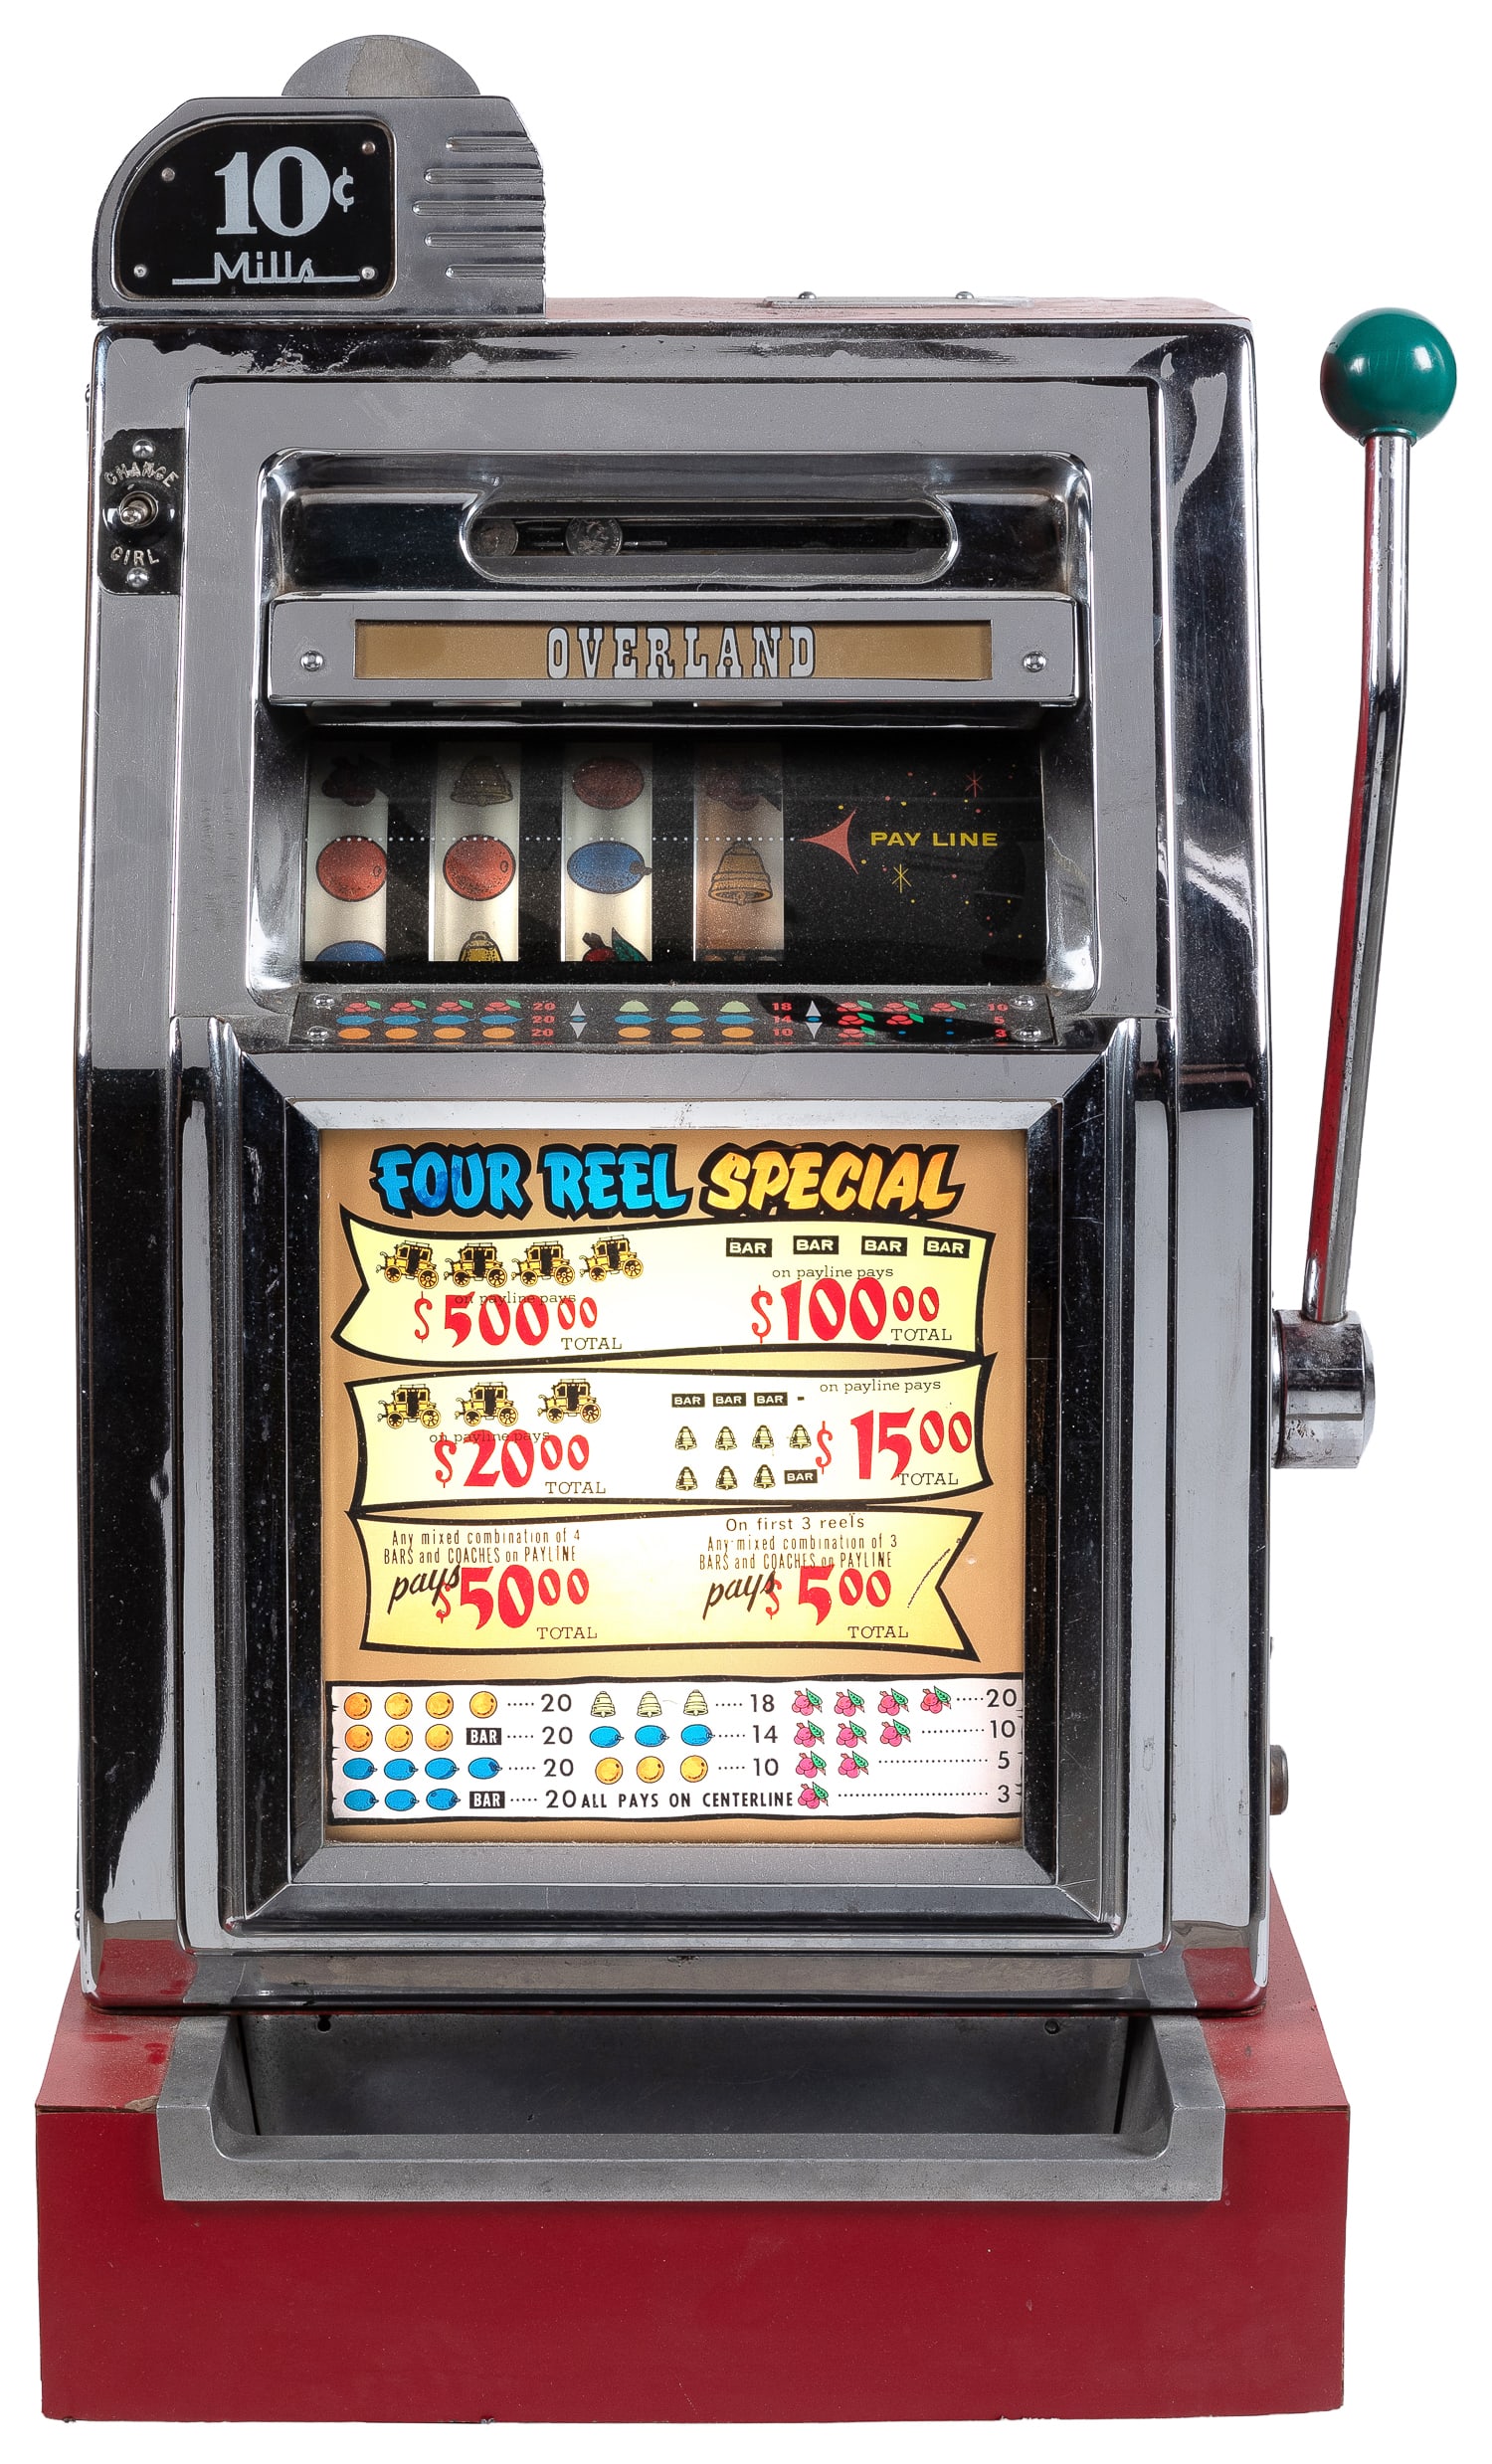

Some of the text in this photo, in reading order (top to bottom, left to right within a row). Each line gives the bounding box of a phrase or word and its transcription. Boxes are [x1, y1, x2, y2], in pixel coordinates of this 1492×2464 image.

[214, 146, 354, 237] 10¢
[213, 251, 315, 284] Mills
[103, 461, 180, 487] CHANGE
[110, 546, 160, 566] GIRL
[547, 625, 816, 679] OVERLAND
[870, 832, 998, 847] PAY LINE
[533, 1002, 556, 1012] 20
[772, 1002, 793, 1012] 18
[532, 1015, 555, 1025] 20
[772, 1015, 792, 1025] 14
[995, 1016, 1005, 1026] 5
[531, 1028, 554, 1038] 20
[995, 1029, 1008, 1039] 3
[374, 1144, 963, 1218] FOUR REEL SPECIAL
[729, 1238, 965, 1255] BAR BAR BAR BAR
[772, 1265, 893, 1280] on payline pays
[455, 1292, 576, 1308] on payline pays
[891, 1328, 952, 1341] TOTAL
[562, 1337, 623, 1350] TOTAL
[820, 1380, 942, 1395] on payline pays
[673, 1394, 785, 1407] BAR BAR BAR
[429, 1432, 448, 1443] on
[513, 1431, 550, 1443] pays
[787, 1471, 814, 1482] BAR
[897, 1472, 959, 1486] TOTAL
[545, 1481, 606, 1494] TOTAL
[726, 1518, 748, 1532] On
[757, 1517, 793, 1531] first
[802, 1517, 812, 1529] 3
[392, 1527, 580, 1550] Any mixed combination of 4
[708, 1534, 897, 1553] Any mixed combination of 3
[384, 1545, 576, 1565] BARS and COACHES on PAYLINE
[699, 1551, 892, 1571] BARS and COACHES on PAYLINE
[387, 1564, 462, 1615] pays
[702, 1568, 776, 1620] pays
[536, 1626, 598, 1640] TOTAL
[847, 1625, 909, 1639] TOTAL
[540, 1693, 572, 1713] 20
[750, 1693, 775, 1713] 18
[986, 1688, 1018, 1708] 20
[470, 1729, 498, 1744] BAR
[541, 1726, 574, 1745] 20
[752, 1725, 779, 1744] 14
[990, 1719, 1016, 1739] 10
[543, 1758, 574, 1778] 20
[753, 1758, 779, 1777] 10
[998, 1751, 1010, 1770] 5
[473, 1794, 501, 1807] BAR
[545, 1790, 577, 1808] 20
[581, 1792, 794, 1808] ALL PAYS ON CENTERLINE
[998, 1785, 1010, 1803] 3
